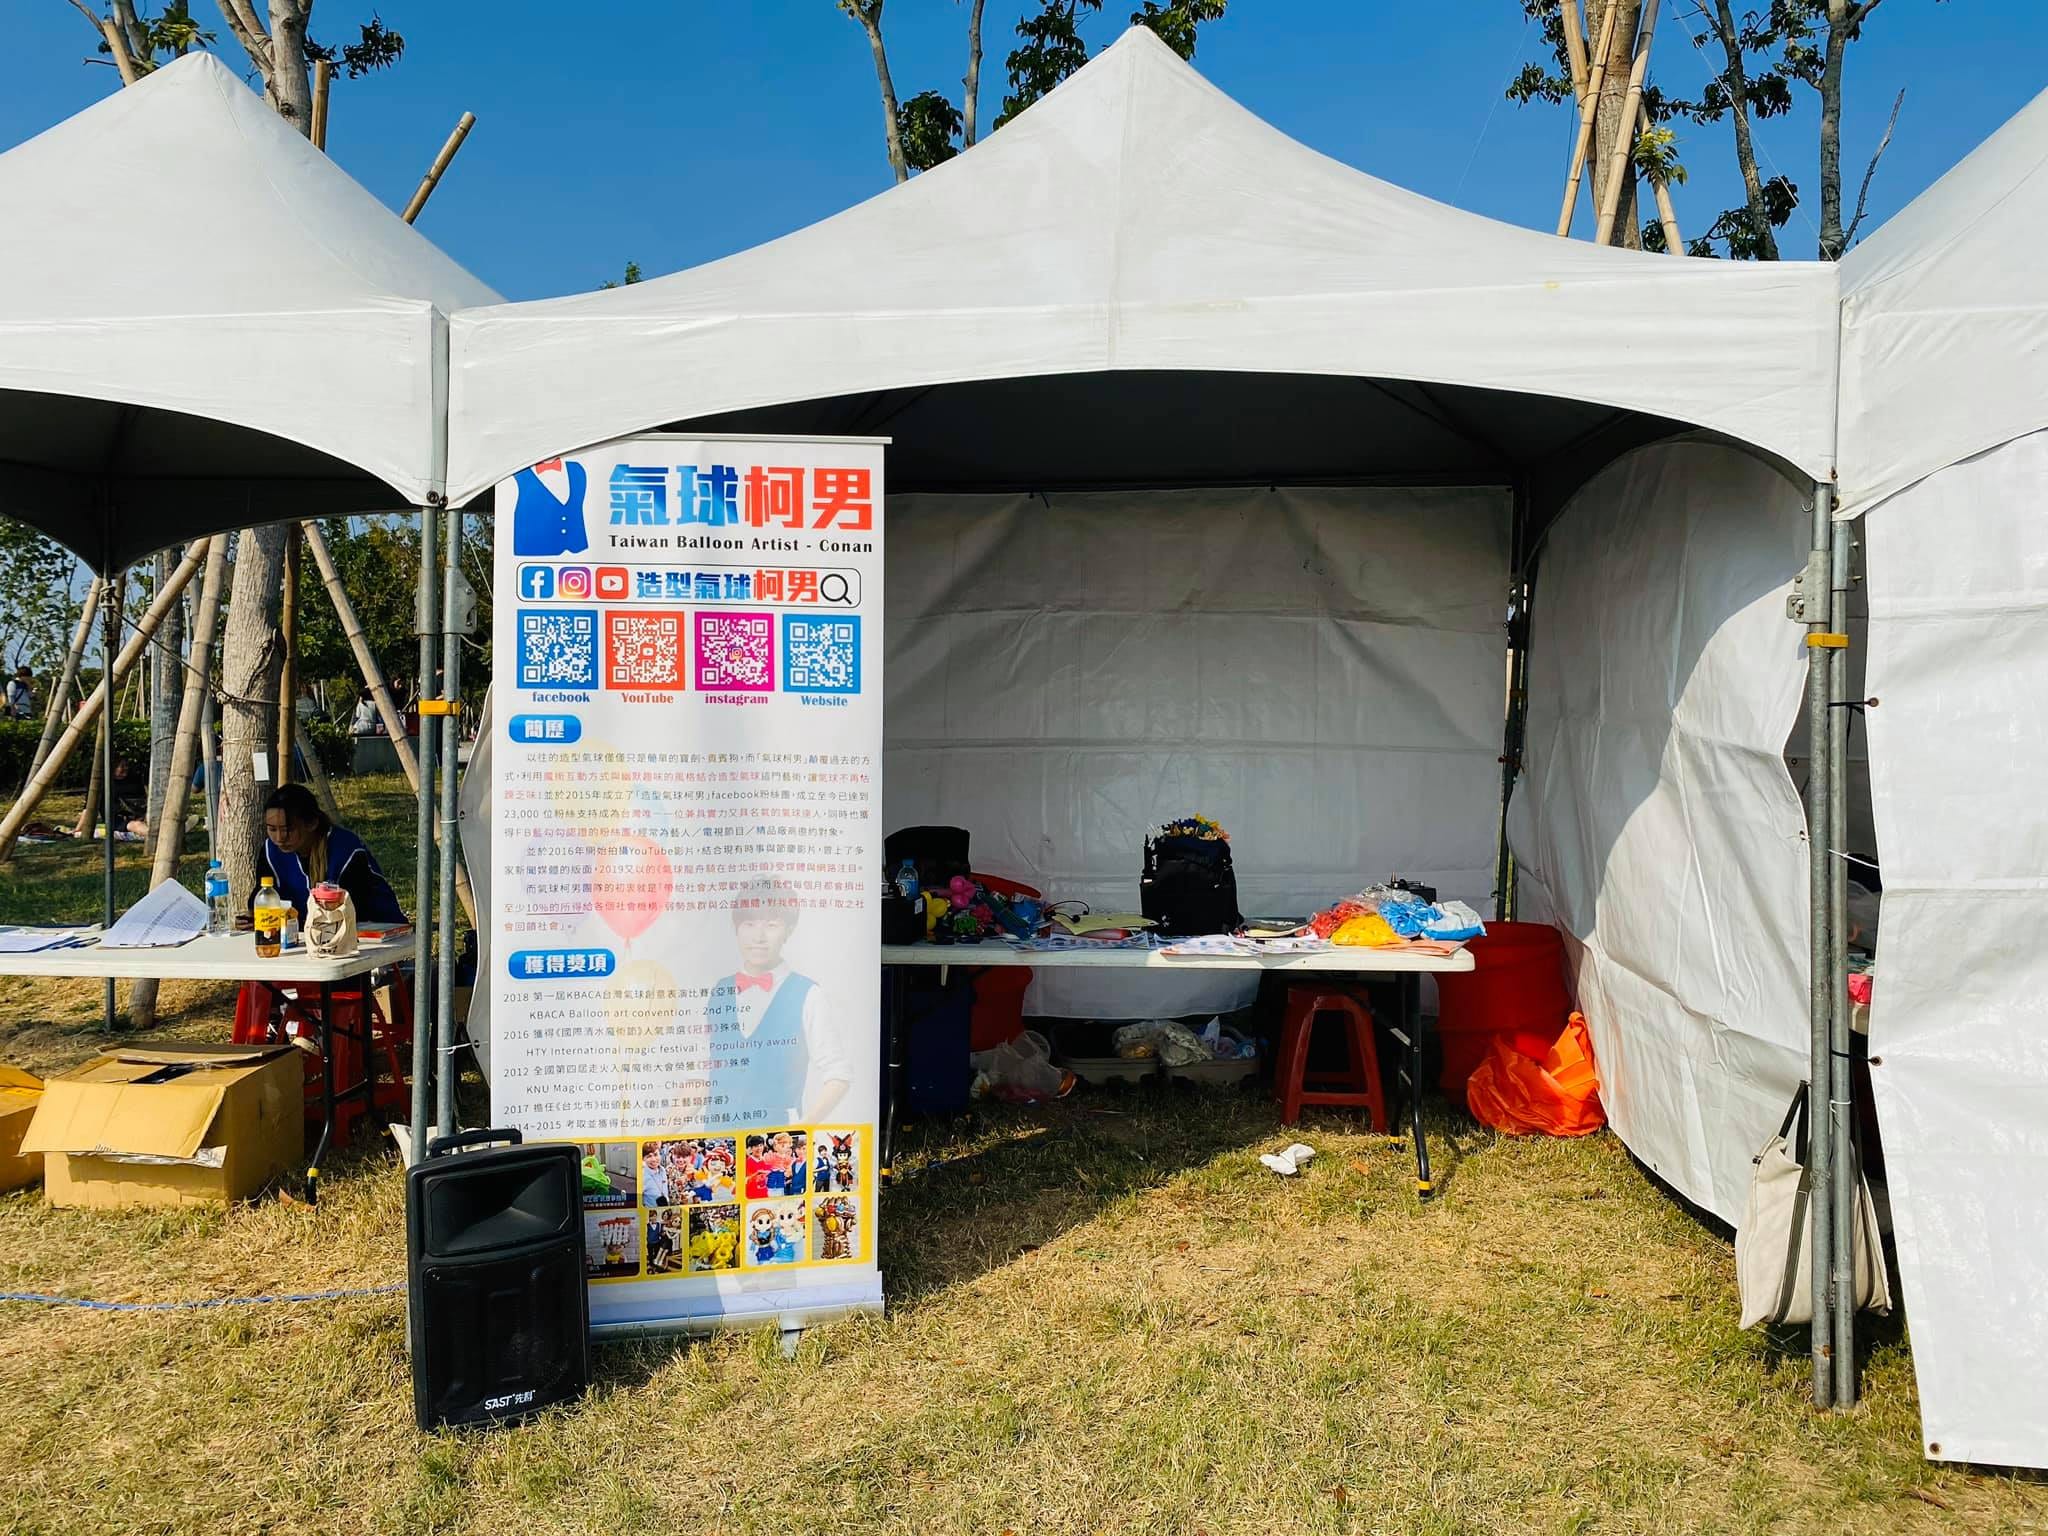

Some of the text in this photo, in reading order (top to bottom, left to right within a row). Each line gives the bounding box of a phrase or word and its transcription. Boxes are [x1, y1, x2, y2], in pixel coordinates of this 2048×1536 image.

[608, 463, 873, 530] 氣球柯男
[608, 535, 669, 548] Taiwan
[676, 536, 744, 550] Balloon
[751, 537, 799, 552] Artist
[819, 539, 873, 553] Conan
[636, 570, 818, 602] 造型氣球柯男
[532, 691, 591, 703] facebook
[622, 692, 674, 704] YouTube
[704, 693, 769, 706] instagram
[800, 694, 848, 707] Website
[524, 719, 566, 739] 簡歷
[504, 809, 539, 820] 23,000
[525, 954, 607, 974] 獲得獎項
[503, 993, 529, 1003] 2018
[530, 1009, 565, 1020] KBACA
[569, 1008, 609, 1018] Balloon
[614, 1009, 629, 1018] art
[632, 1007, 691, 1018] convention
[702, 1006, 722, 1016] 2nd
[726, 1004, 751, 1014] Prize
[503, 1030, 529, 1040] 2016
[526, 1048, 547, 1057] HTY
[551, 1045, 621, 1056] International
[625, 1046, 656, 1057] magic
[659, 1043, 698, 1054] festival
[709, 1040, 767, 1052] Popularity
[767, 1037, 797, 1047] award
[503, 1068, 529, 1078] 2012
[526, 1084, 549, 1094] KNU
[553, 1083, 584, 1095] Magic
[588, 1080, 654, 1093] Competition
[665, 1078, 718, 1090] Champion
[503, 1105, 529, 1115] 2017
[484, 1395, 512, 1410] SAST
